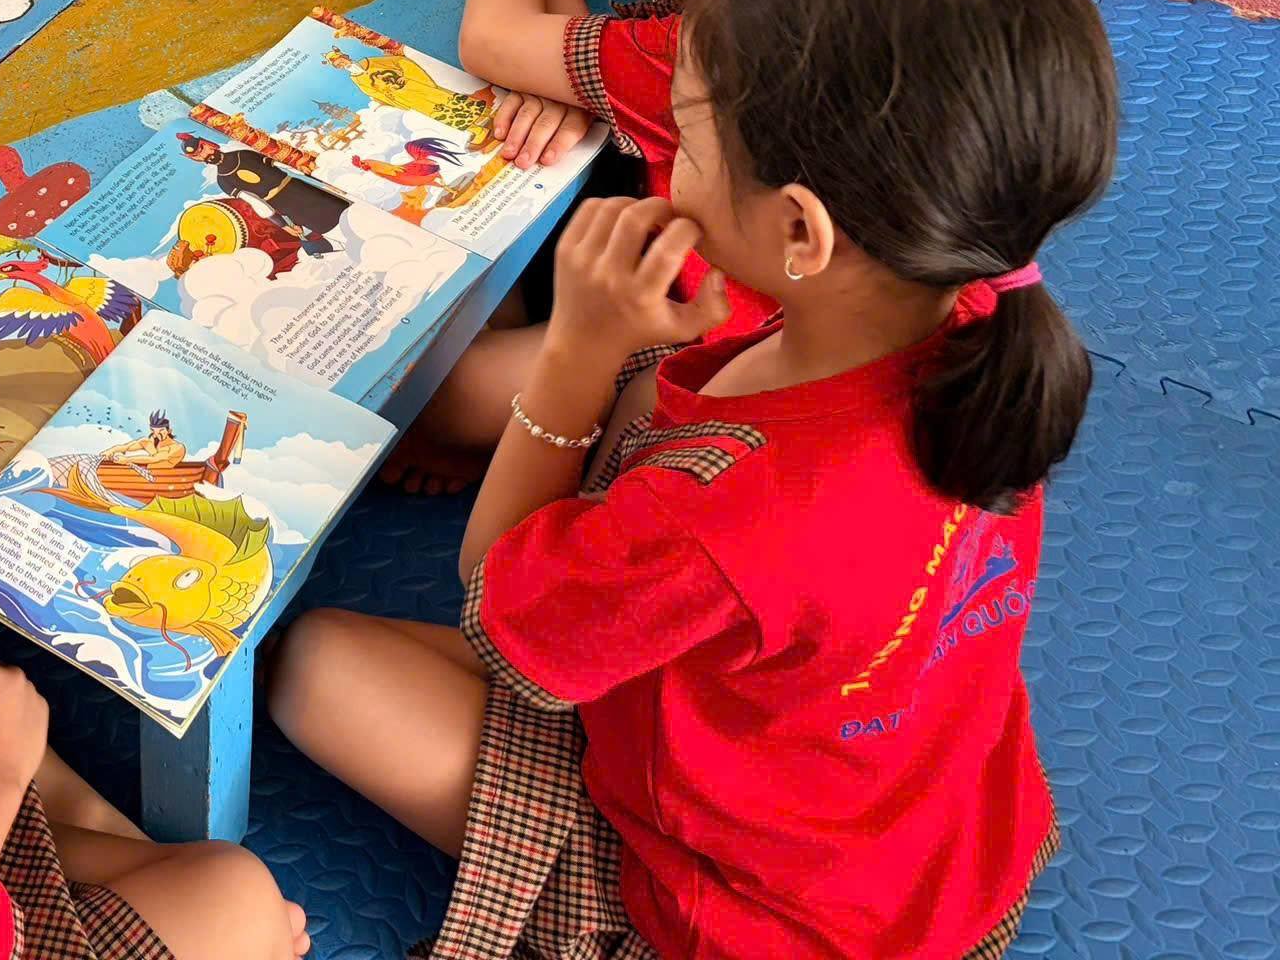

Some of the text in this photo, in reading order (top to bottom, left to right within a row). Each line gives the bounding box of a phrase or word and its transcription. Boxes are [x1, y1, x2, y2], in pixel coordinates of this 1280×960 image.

[270, 265, 354, 344] The Jade Emperor was shocked by
[277, 344, 288, 353] the
[327, 289, 345, 306] angrily
[342, 278, 355, 289] told
[351, 271, 363, 280] the
[285, 338, 309, 359] Thunder
[308, 326, 321, 338] God
[327, 313, 335, 321] go
[334, 295, 353, 313] outside
[353, 284, 363, 295] and
[362, 276, 372, 285] see
[297, 351, 312, 364] what
[312, 340, 324, 350] was
[349, 302, 362, 311] The
[360, 281, 382, 300] Thunder
[307, 286, 393, 370] God came outside and was surprised
[325, 358, 338, 369] only
[336, 348, 347, 358] see
[348, 330, 364, 343] Toad
[381, 297, 397, 311] front
[327, 372, 339, 382] the
[337, 359, 352, 374] gates
[350, 351, 358, 360] of
[0, 520, 9, 529] for
[10, 526, 24, 537] fish
[24, 536, 40, 546] and
[63, 559, 75, 568] All
[10, 503, 88, 553] Some others had
[31, 527, 47, 540] dive
[49, 537, 64, 550] into
[67, 549, 80, 560] the
[5, 572, 18, 583] the
[18, 580, 47, 602] throne.
[15, 565, 24, 574] to
[24, 571, 37, 582] the
[37, 579, 54, 595] King
[25, 561, 42, 572] and
[45, 572, 60, 585] rare
[27, 549, 54, 568] wanted
[58, 568, 68, 576] to
